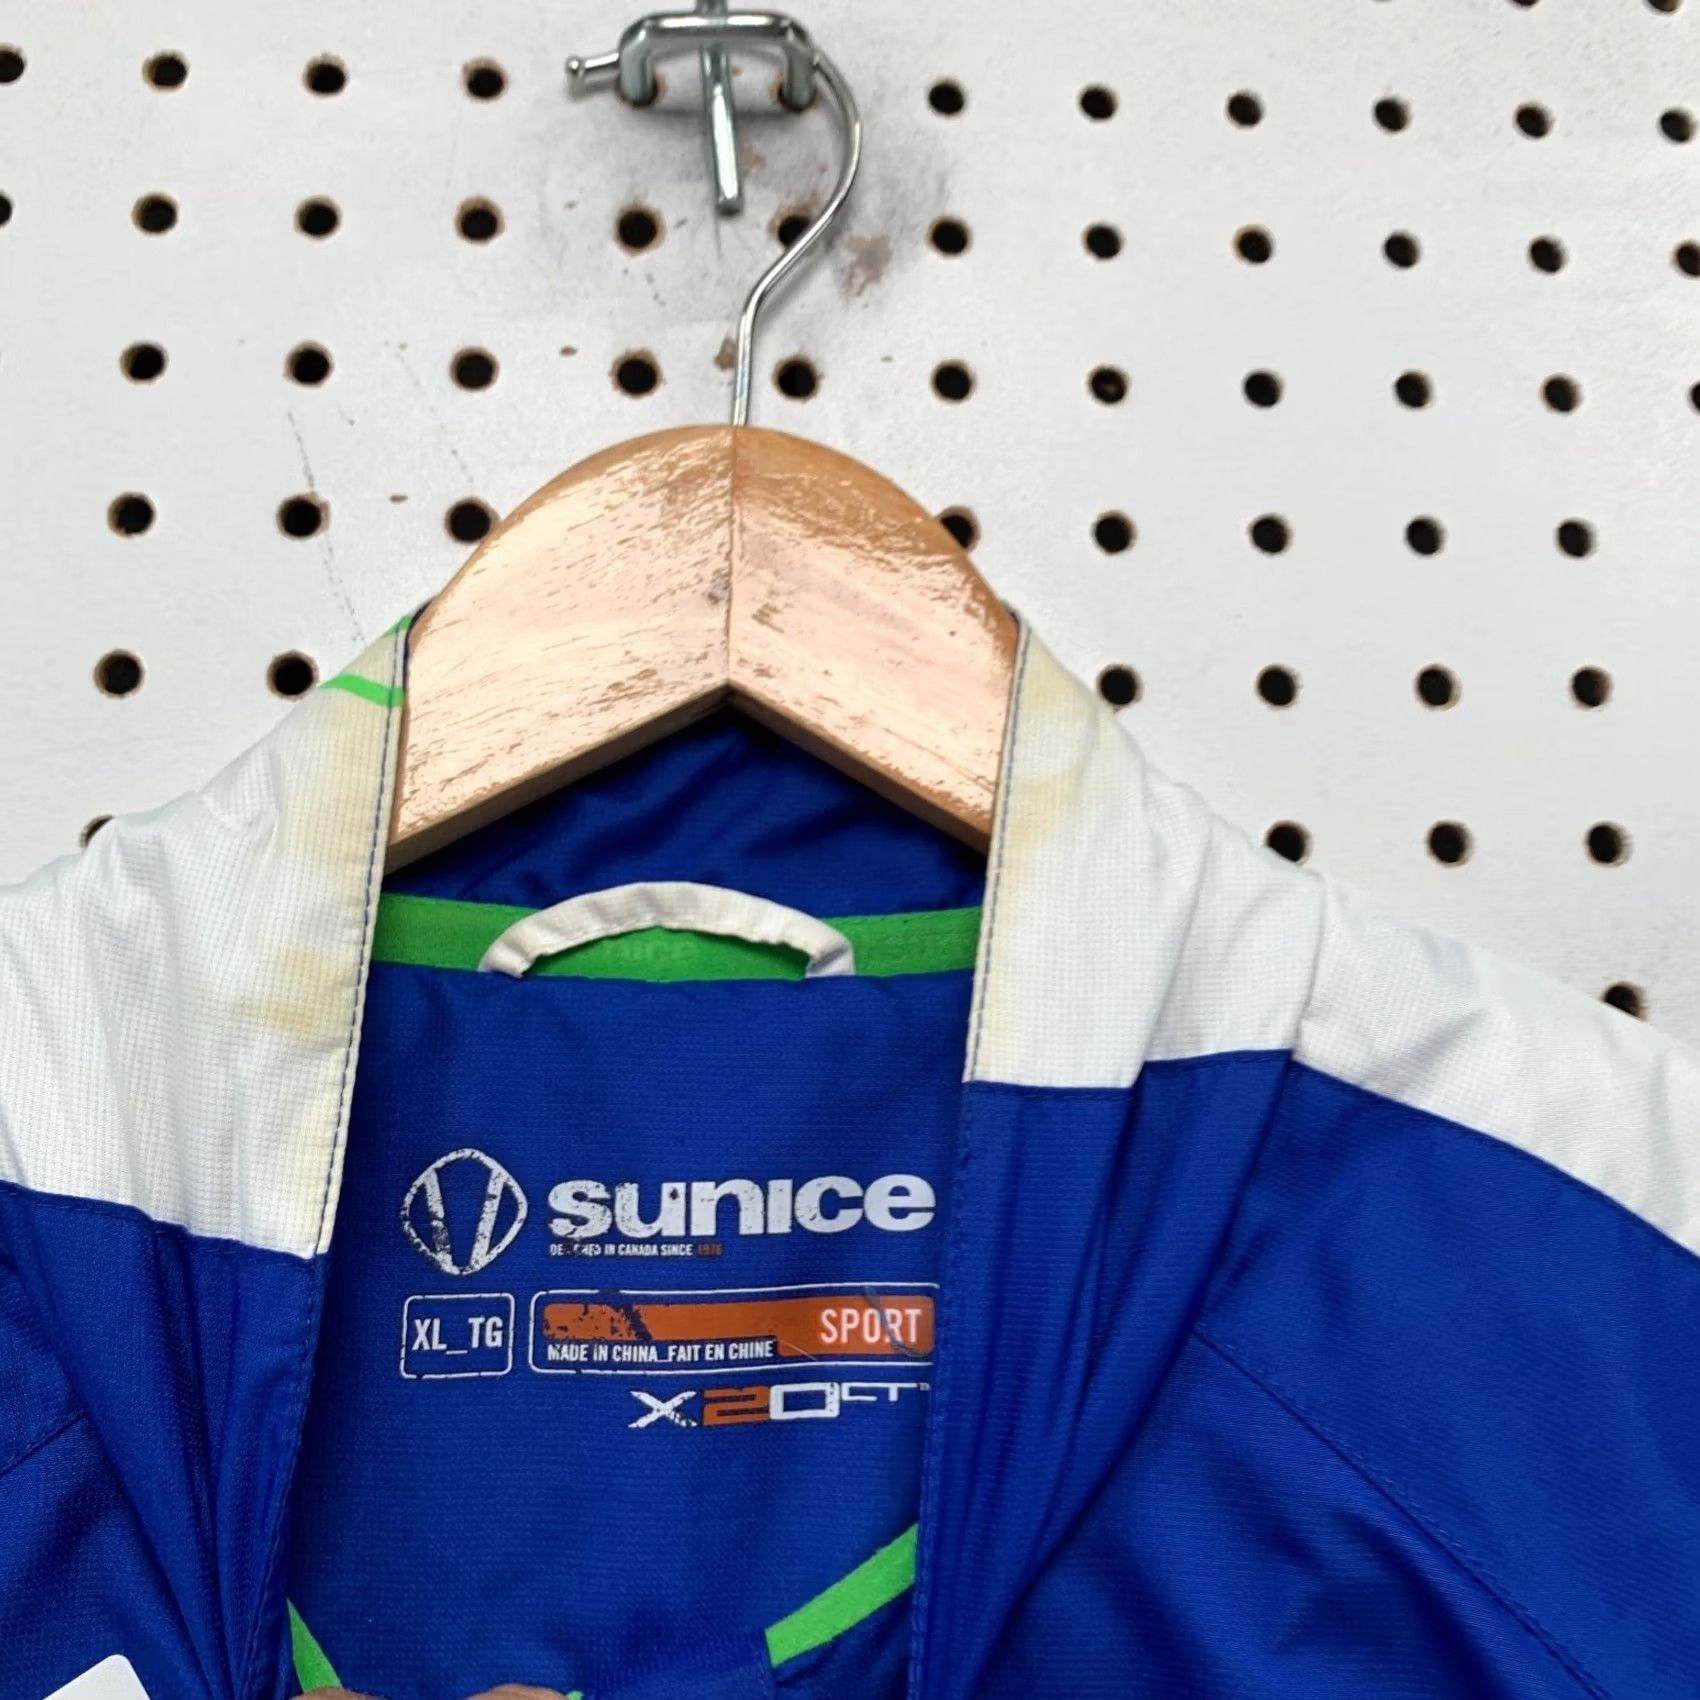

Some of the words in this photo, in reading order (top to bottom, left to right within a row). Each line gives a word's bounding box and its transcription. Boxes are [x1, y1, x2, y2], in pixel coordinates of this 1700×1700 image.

[604, 1243, 616, 1256] IN
[617, 1243, 659, 1256] CANADA
[660, 1243, 693, 1256] SINCE
[820, 1307, 923, 1345] SPORT
[547, 1344, 589, 1361] MADE
[593, 1344, 609, 1361] IN
[704, 1343, 725, 1361] EN
[728, 1341, 775, 1359] CHINE
